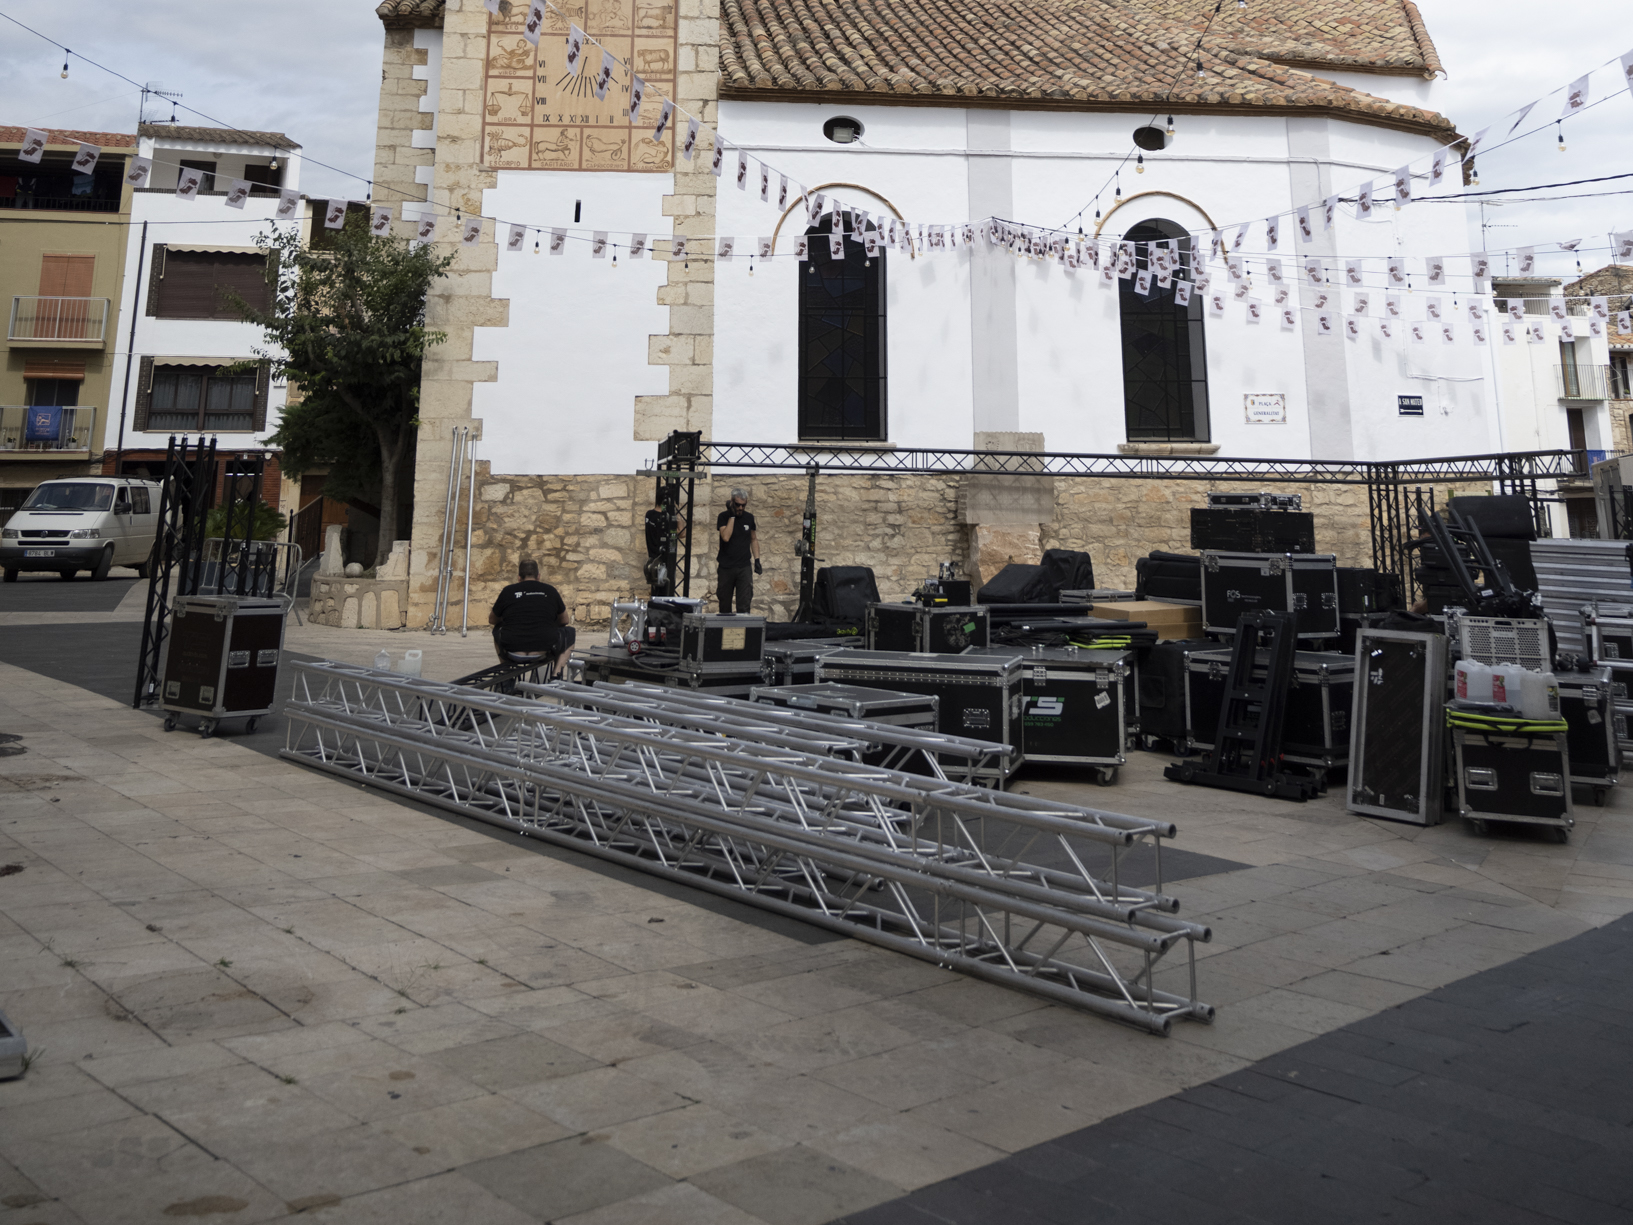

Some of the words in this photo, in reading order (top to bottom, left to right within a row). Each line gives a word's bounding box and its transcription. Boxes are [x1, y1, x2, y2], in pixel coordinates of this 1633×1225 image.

[538, 60, 546, 68] VI
[623, 58, 630, 66] VI
[537, 76, 546, 84] VII
[622, 84, 630, 92] IV
[536, 97, 546, 105] VIII
[542, 114, 550, 122] IX
[558, 114, 564, 122] X
[569, 115, 576, 124] XI
[580, 115, 589, 124] XII
[596, 116, 598, 124] I
[610, 116, 614, 124] II
[1227, 590, 1240, 598] FOS
